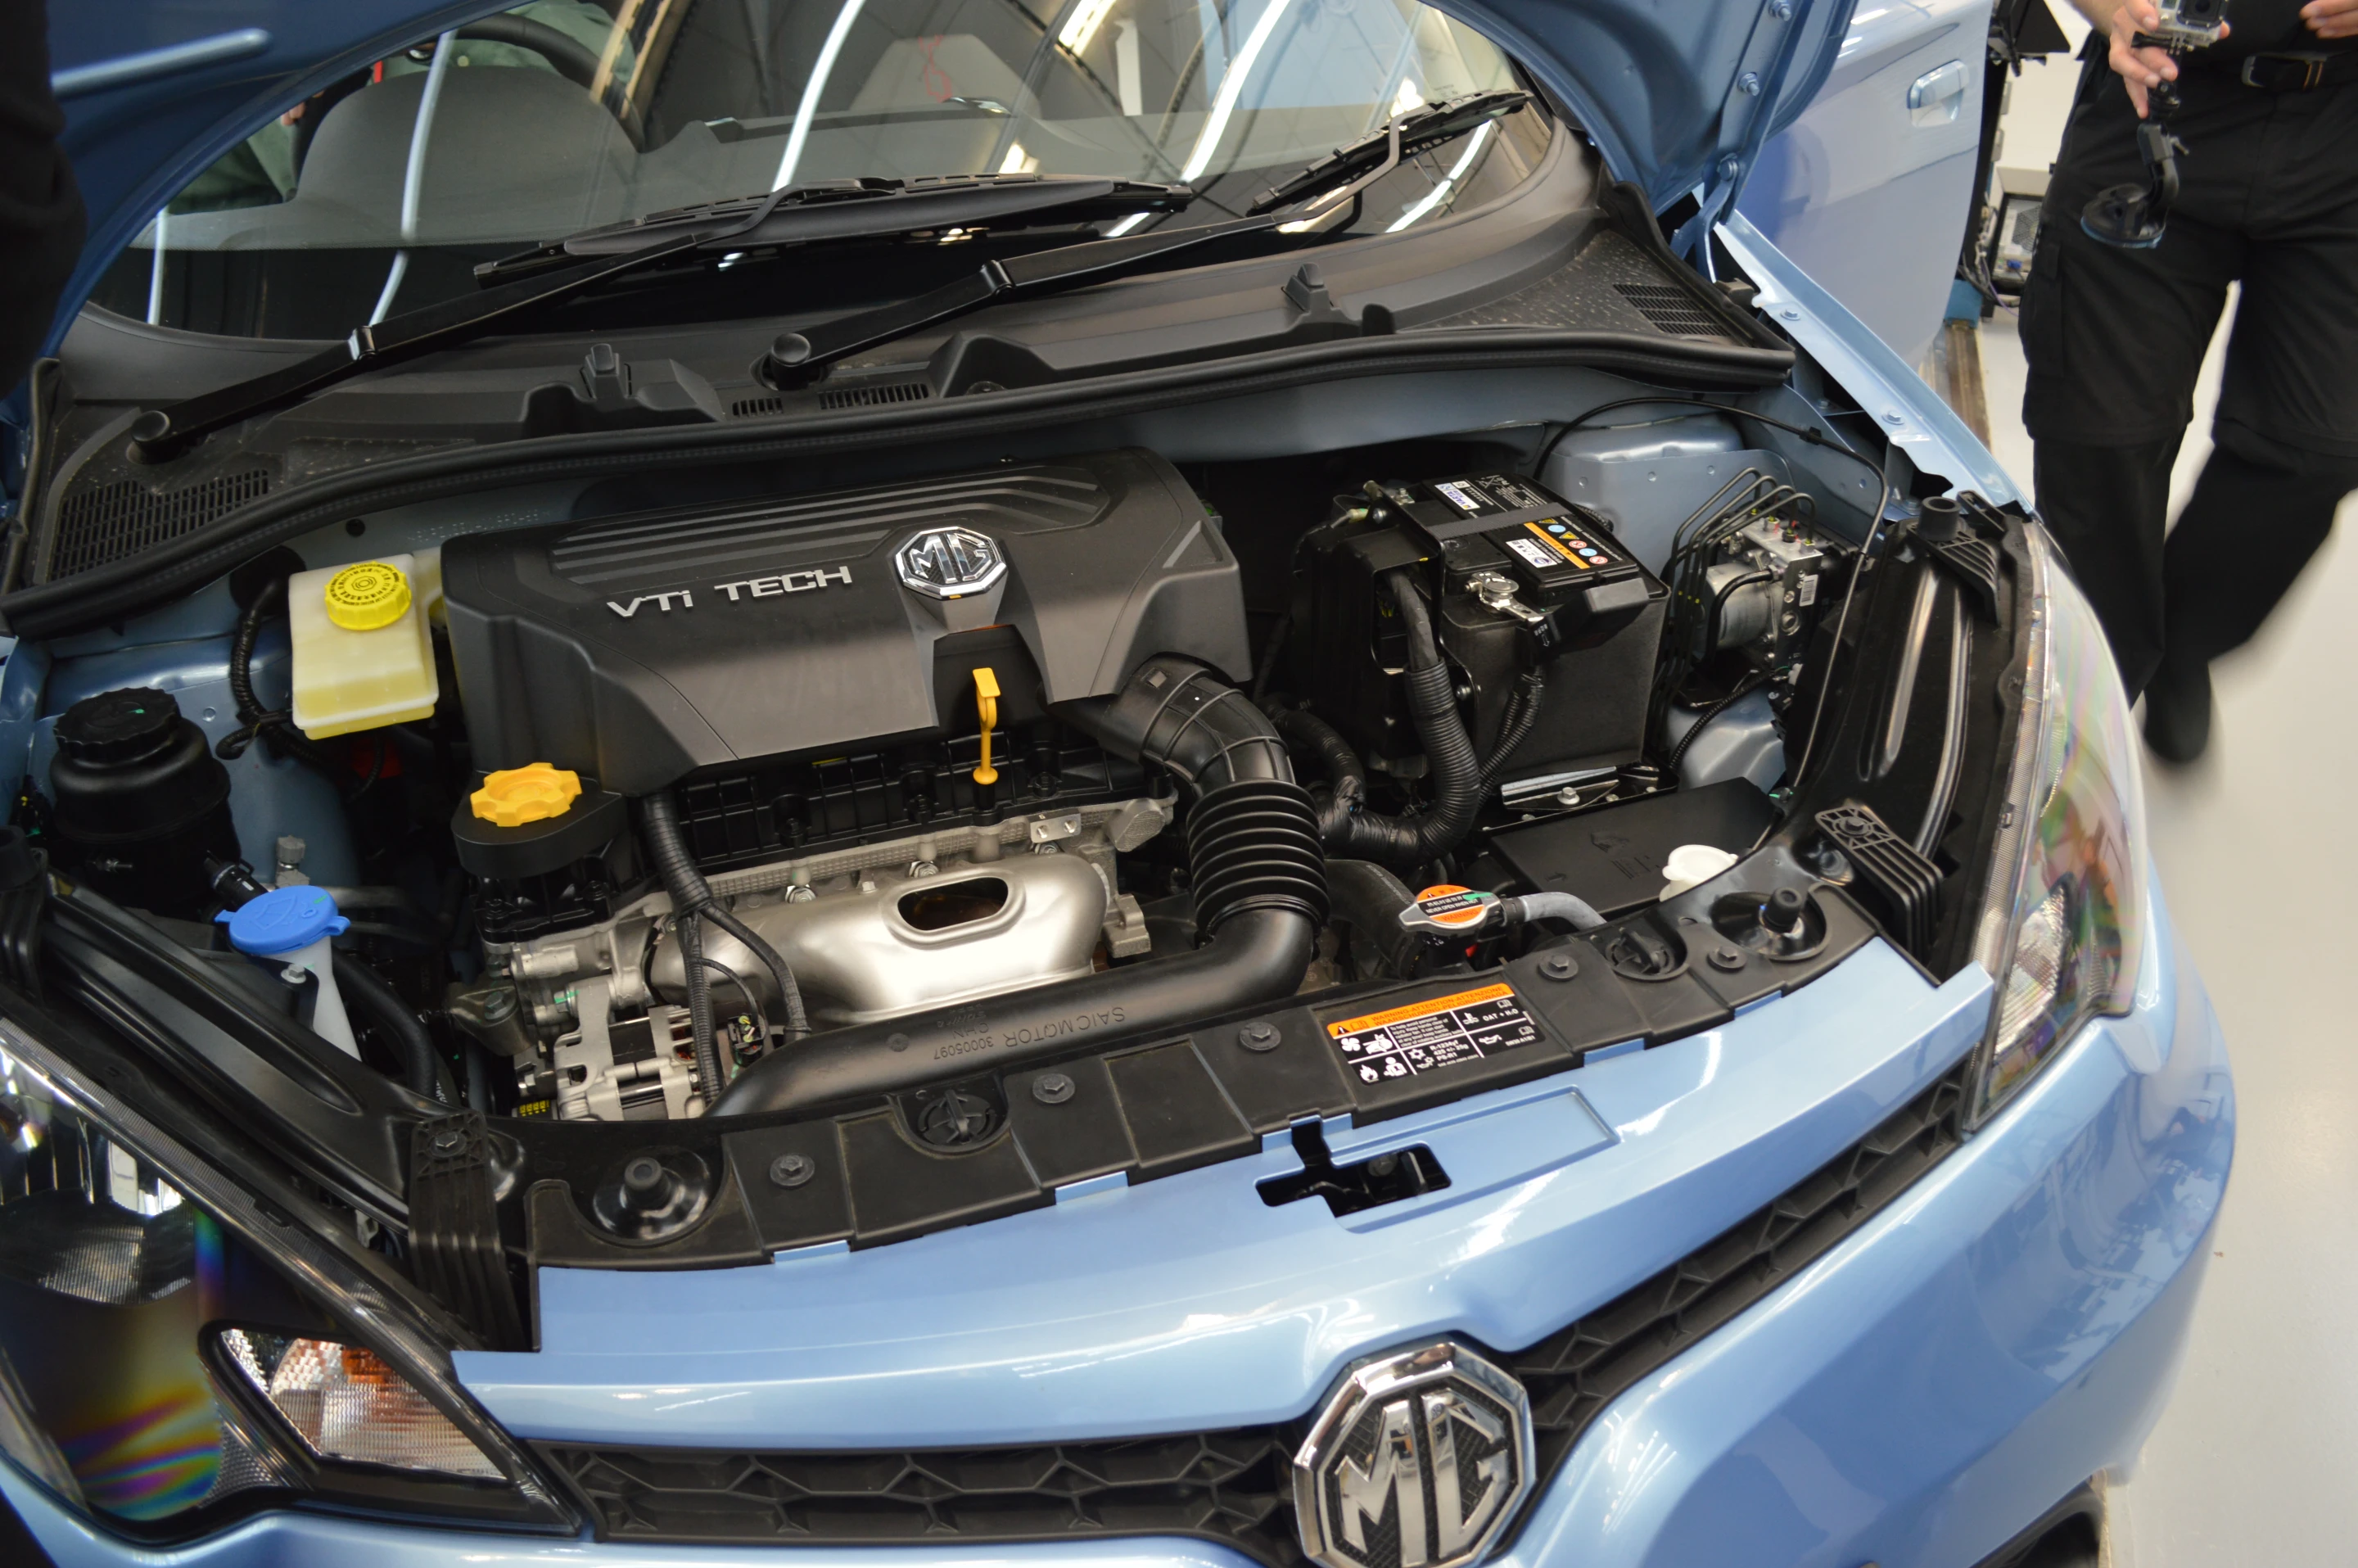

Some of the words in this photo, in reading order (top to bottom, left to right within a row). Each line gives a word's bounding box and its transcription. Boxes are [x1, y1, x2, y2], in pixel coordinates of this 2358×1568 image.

[910, 532, 992, 584] MG
[607, 590, 693, 617] VTi
[714, 566, 852, 601] TECH
[1442, 909, 1479, 920] WARNING
[1077, 1006, 1125, 1030] SAIC
[1482, 1013, 1497, 1021] OAT
[1003, 1019, 1073, 1047] MOTOR
[933, 1036, 994, 1060] 30005097
[1334, 1388, 1508, 1567] MG
